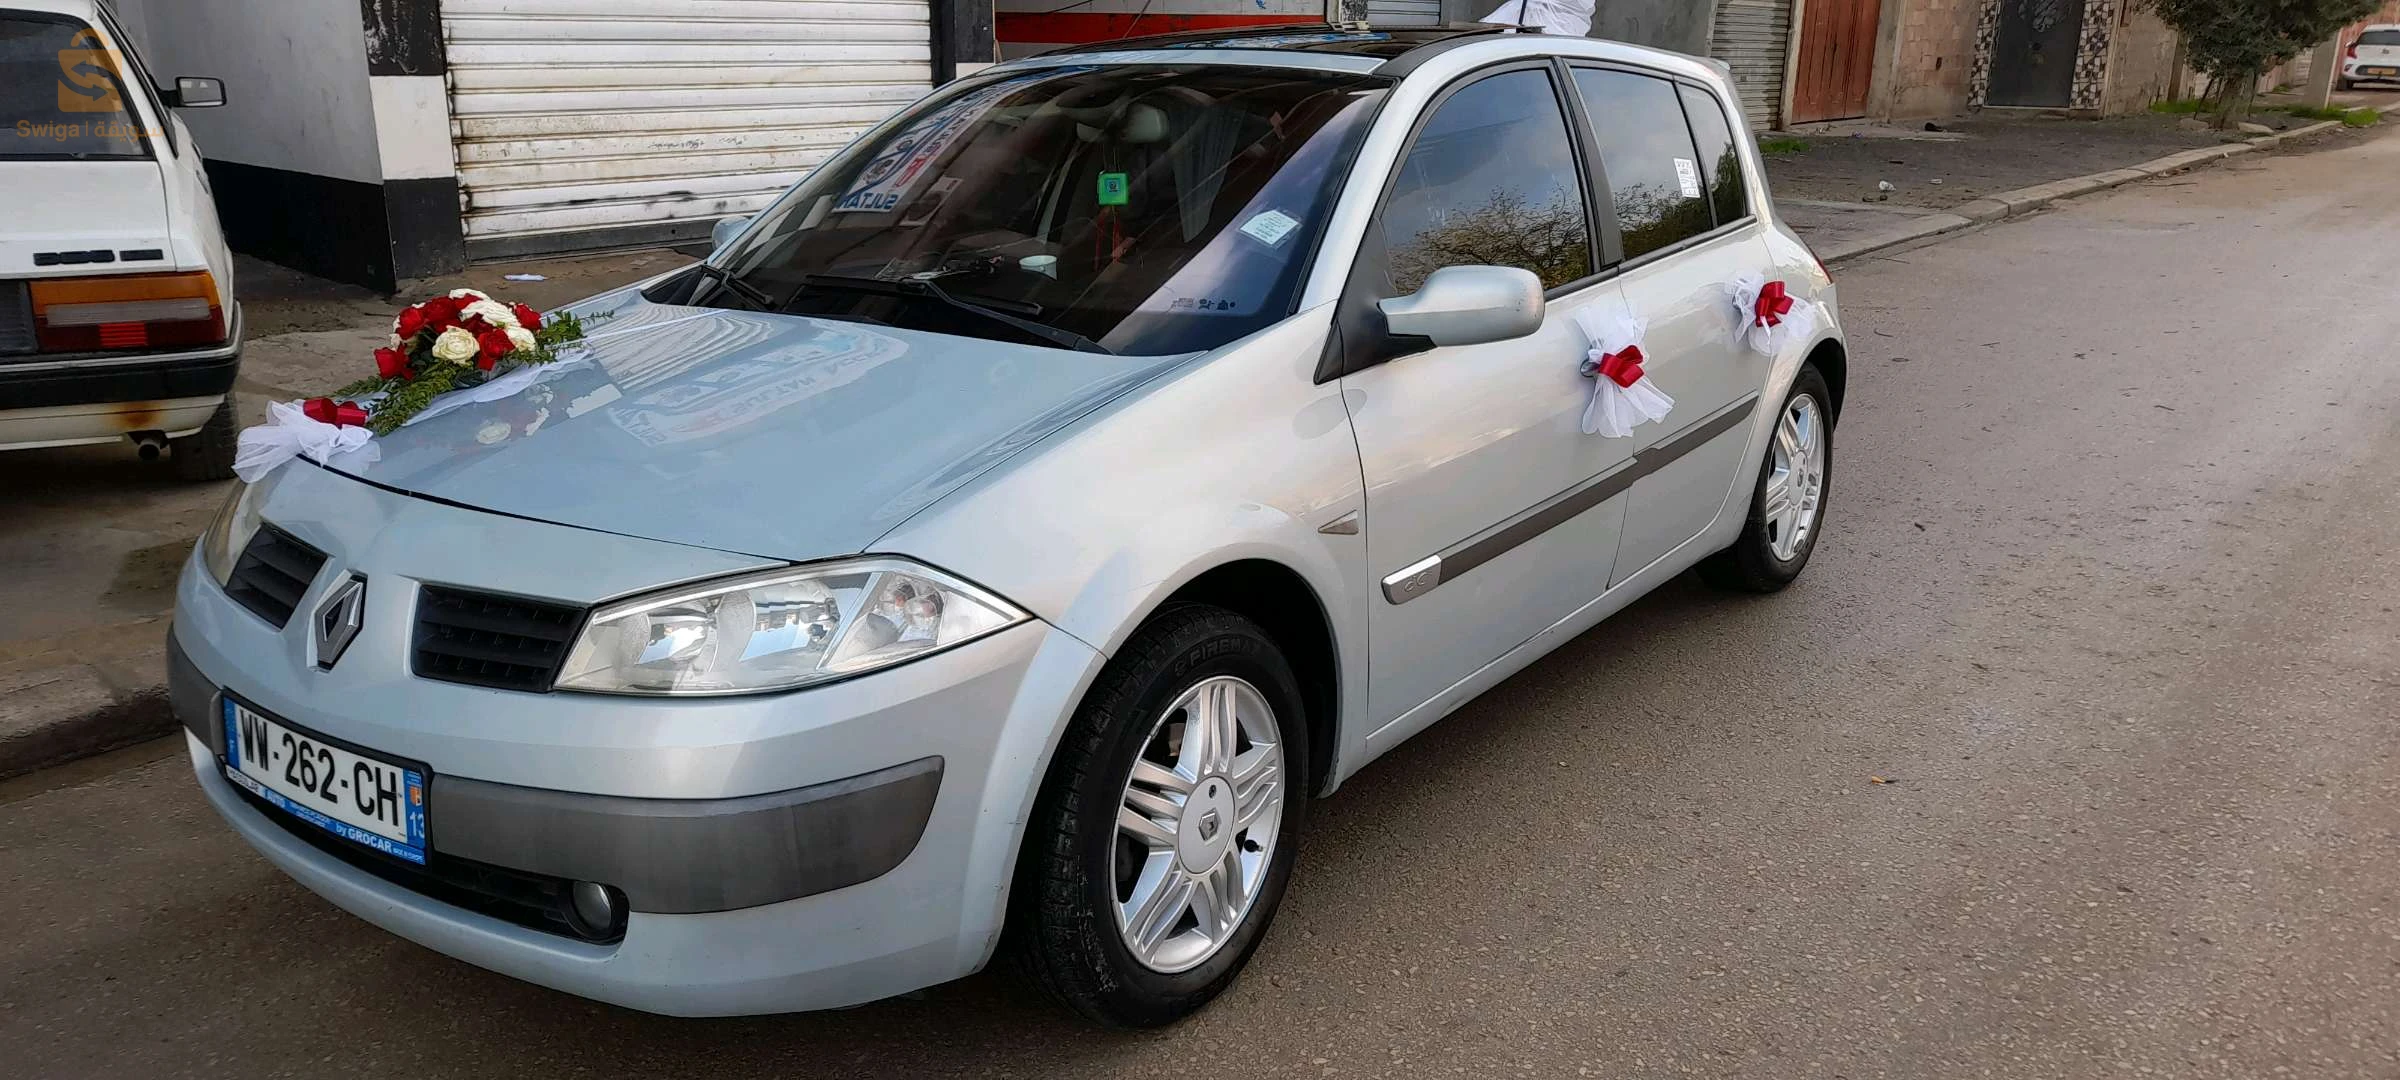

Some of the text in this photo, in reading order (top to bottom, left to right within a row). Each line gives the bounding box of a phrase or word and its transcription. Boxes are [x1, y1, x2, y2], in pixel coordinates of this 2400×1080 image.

[335, 822, 393, 854] by GROCAR
[409, 811, 425, 839] 13
